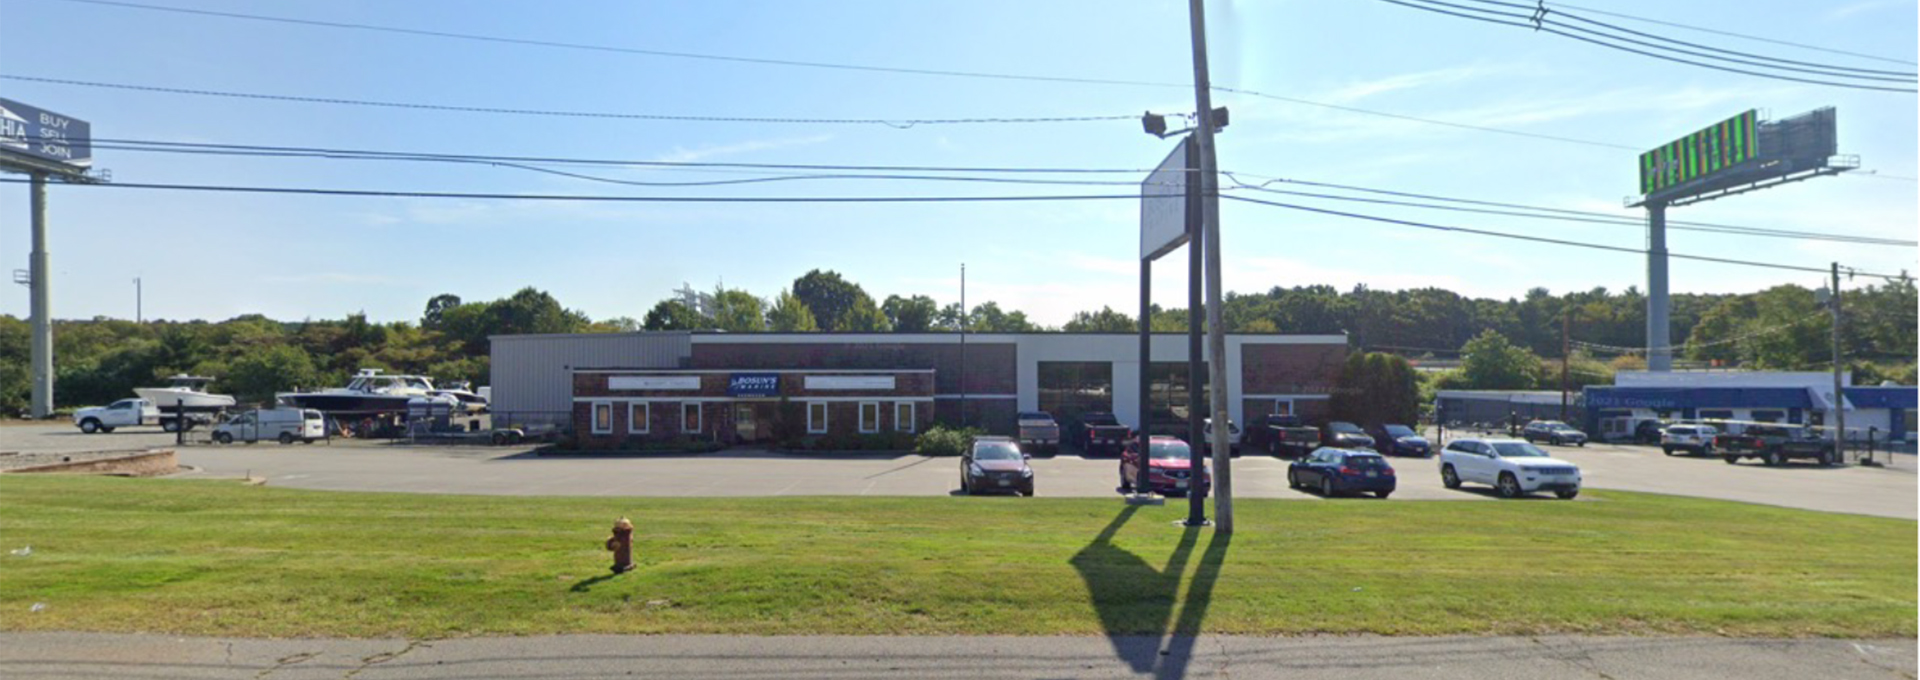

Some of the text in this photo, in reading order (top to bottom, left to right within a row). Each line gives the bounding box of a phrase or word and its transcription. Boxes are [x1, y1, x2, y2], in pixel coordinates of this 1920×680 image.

[40, 113, 69, 130] BUY
[40, 128, 69, 145] SELL
[40, 142, 71, 158] JOIN
[738, 376, 777, 385] BOSUN'S
